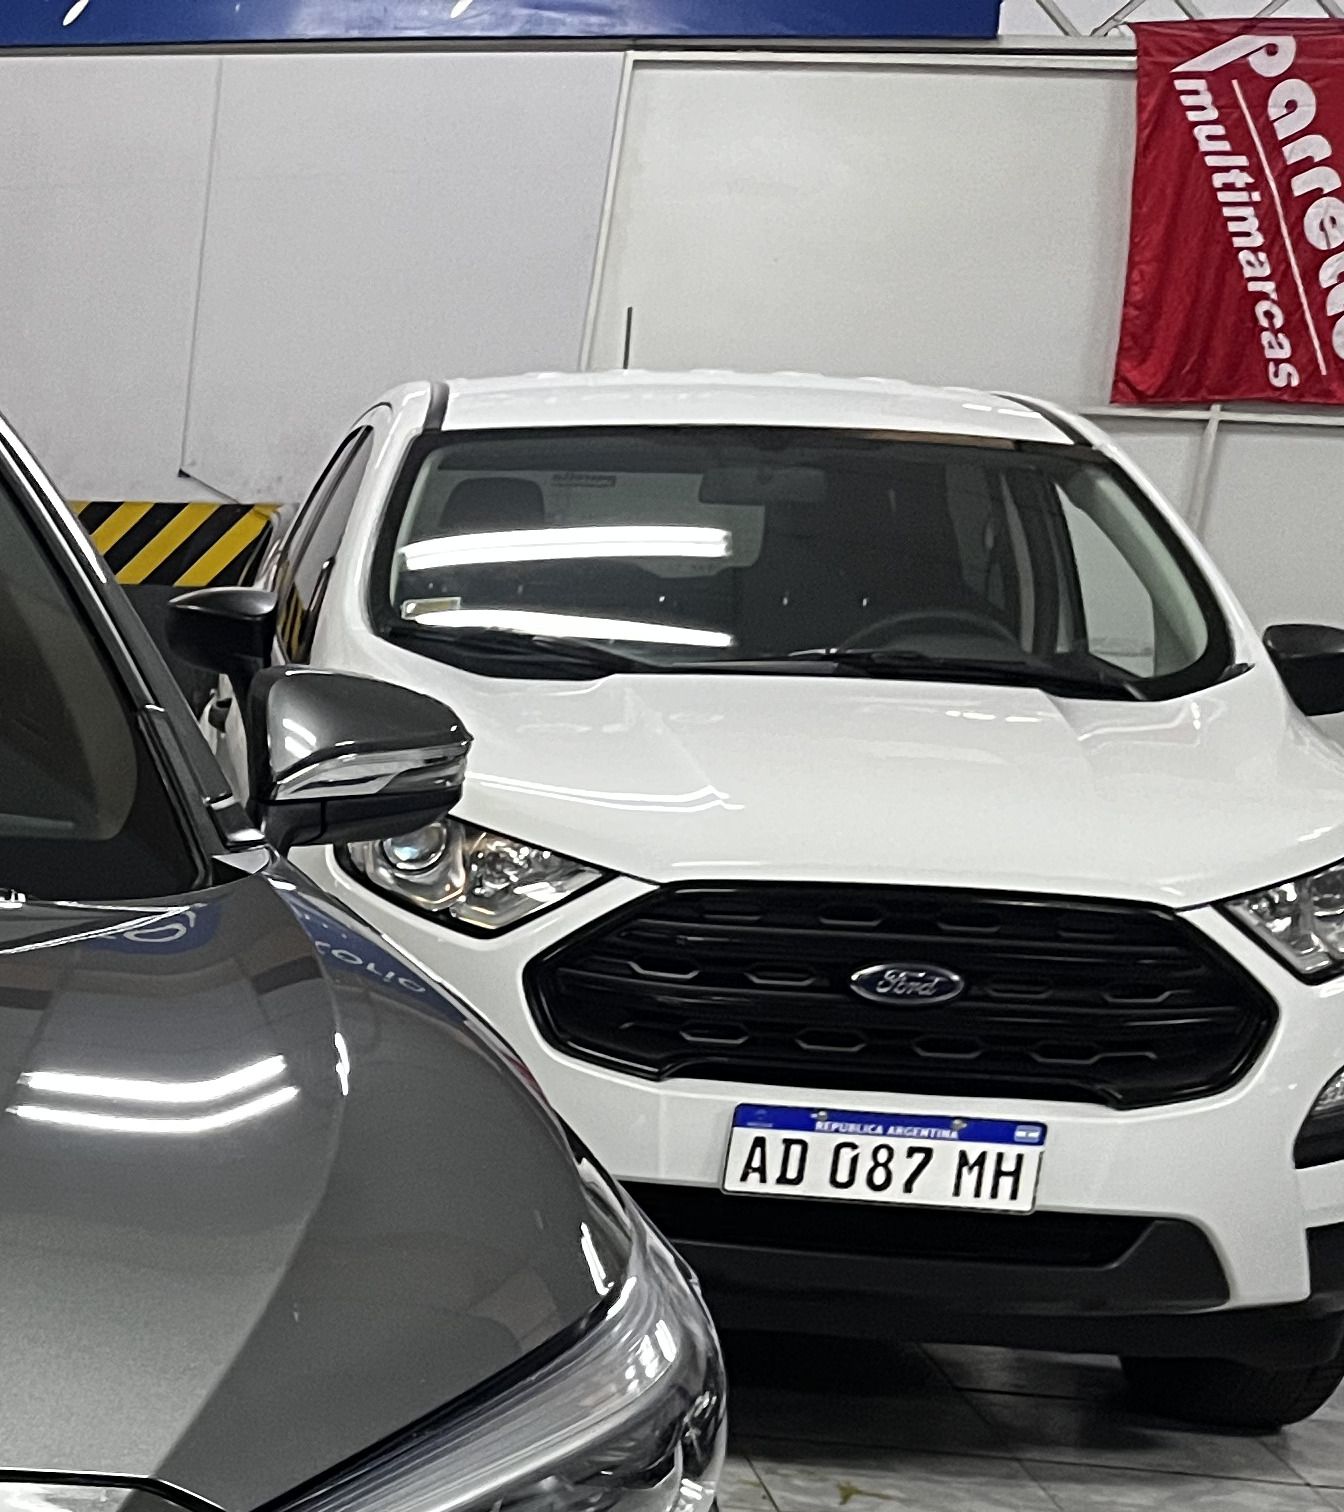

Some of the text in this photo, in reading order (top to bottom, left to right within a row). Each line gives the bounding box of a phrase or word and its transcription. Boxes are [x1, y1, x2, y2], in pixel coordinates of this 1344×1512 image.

[1172, 78, 1301, 389] multimarcas
[886, 1125, 959, 1140] ARGENTINA
[738, 1135, 1025, 1201] AD 087 MH
